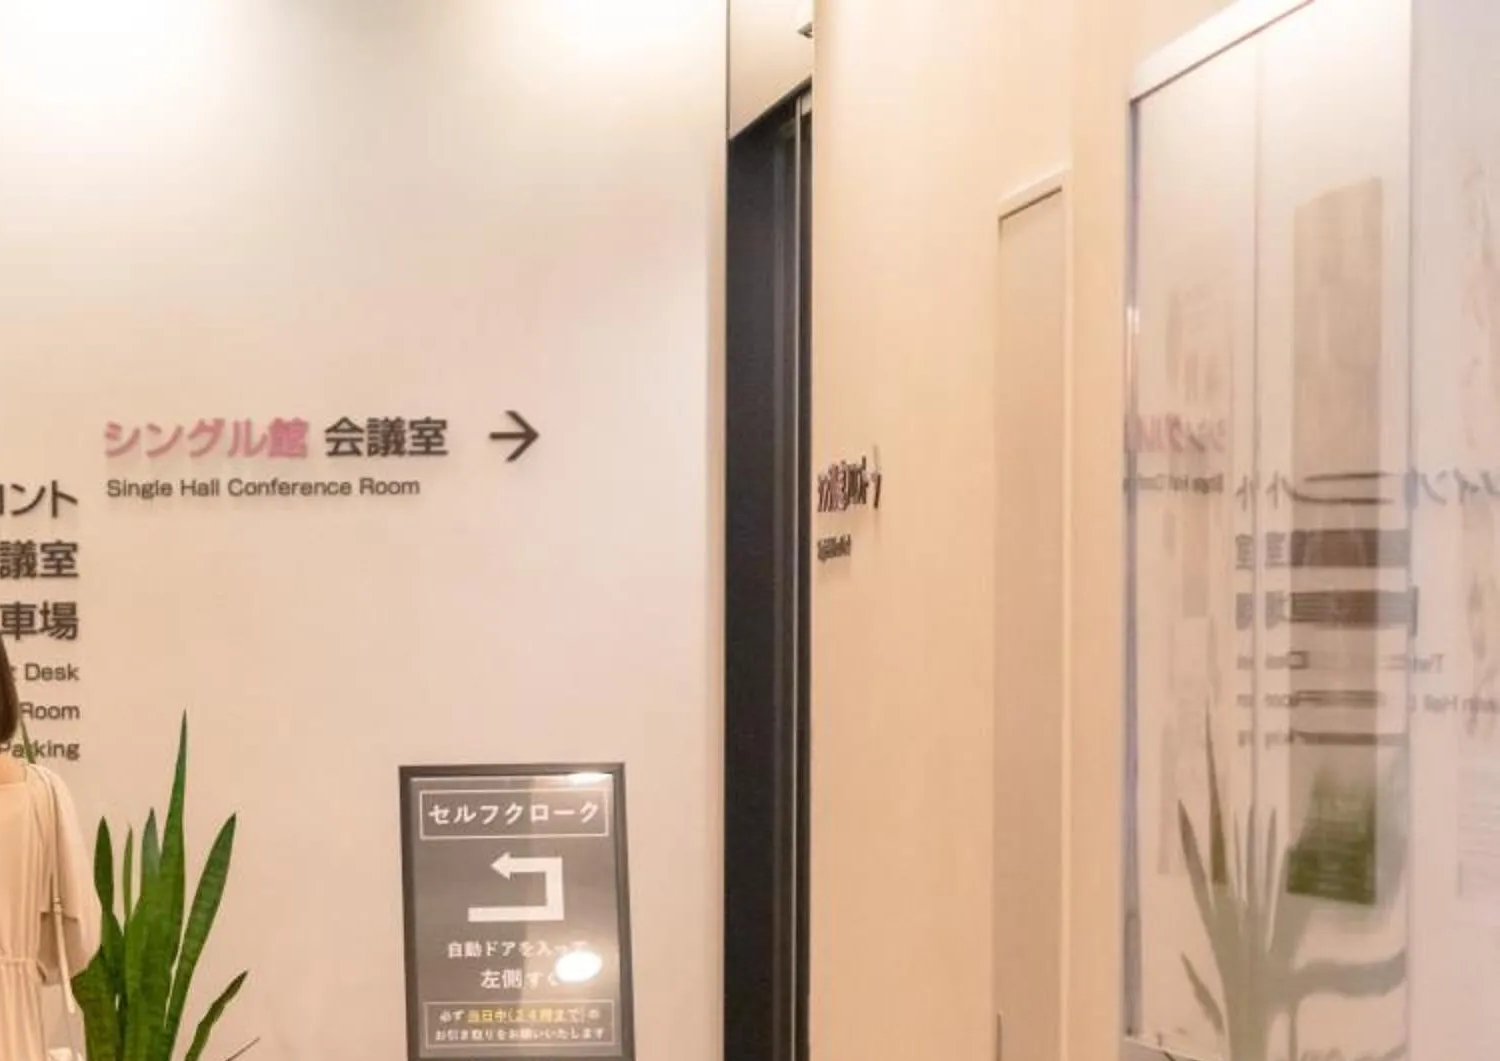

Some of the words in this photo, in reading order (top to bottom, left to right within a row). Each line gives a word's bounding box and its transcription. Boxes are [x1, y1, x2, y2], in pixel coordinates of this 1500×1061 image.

[104, 417, 309, 459] シングル館
[324, 416, 448, 457] 会議室
[107, 480, 173, 499] Single
[180, 479, 220, 497] Hall
[227, 478, 352, 497] Conference
[359, 478, 420, 495] Room
[24, 663, 80, 681] Desk
[429, 803, 599, 825] セルフクローク
[447, 940, 588, 959] 自動ドアを入っ
